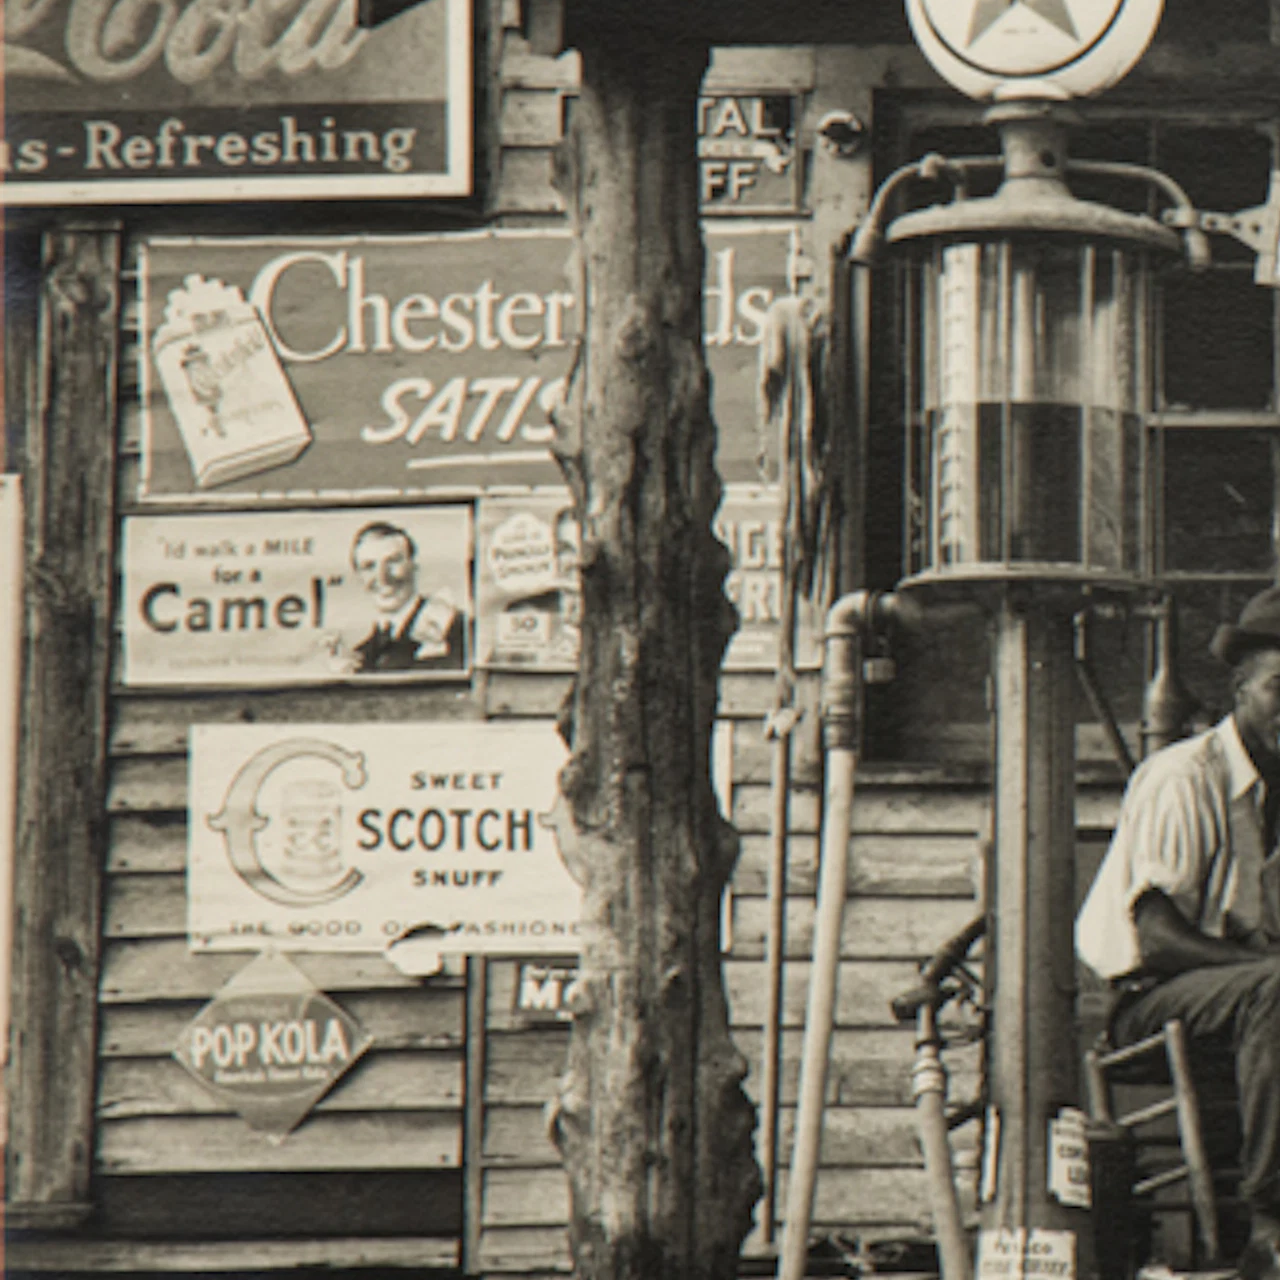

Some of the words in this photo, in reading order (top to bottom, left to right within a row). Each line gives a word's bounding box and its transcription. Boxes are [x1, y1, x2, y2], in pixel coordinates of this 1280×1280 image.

[410, 771, 505, 791] SWEET
[356, 808, 534, 852] SCOTCH
[411, 869, 505, 888] SNUFF
[190, 1024, 256, 1069] POP
[259, 1018, 350, 1066] KOLA
